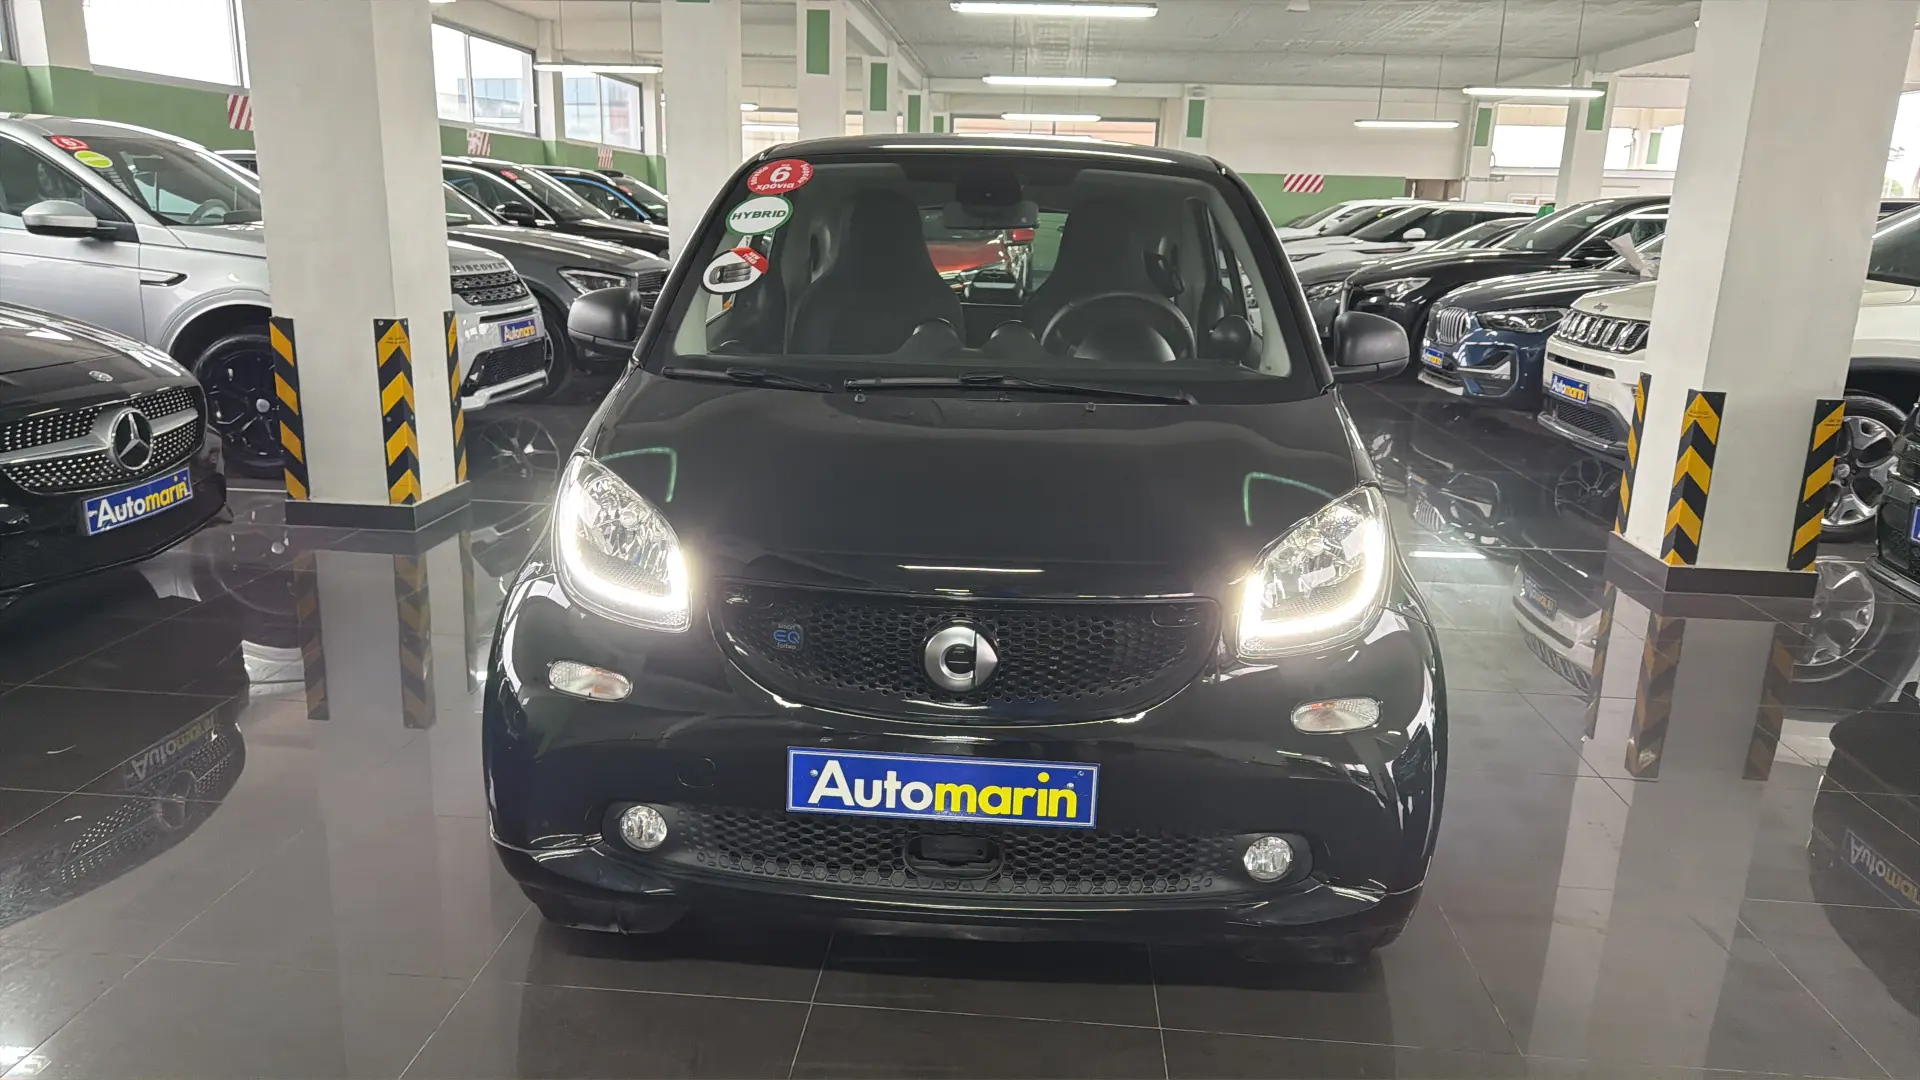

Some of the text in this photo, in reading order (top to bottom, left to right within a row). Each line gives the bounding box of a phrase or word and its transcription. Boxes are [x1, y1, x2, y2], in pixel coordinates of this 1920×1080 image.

[769, 166, 792, 183] 6
[756, 182, 795, 191] χρόνια
[731, 210, 786, 220] HYBRID
[97, 475, 188, 528] Automarin
[773, 629, 800, 644] EQ
[807, 759, 1077, 818] Automarin
